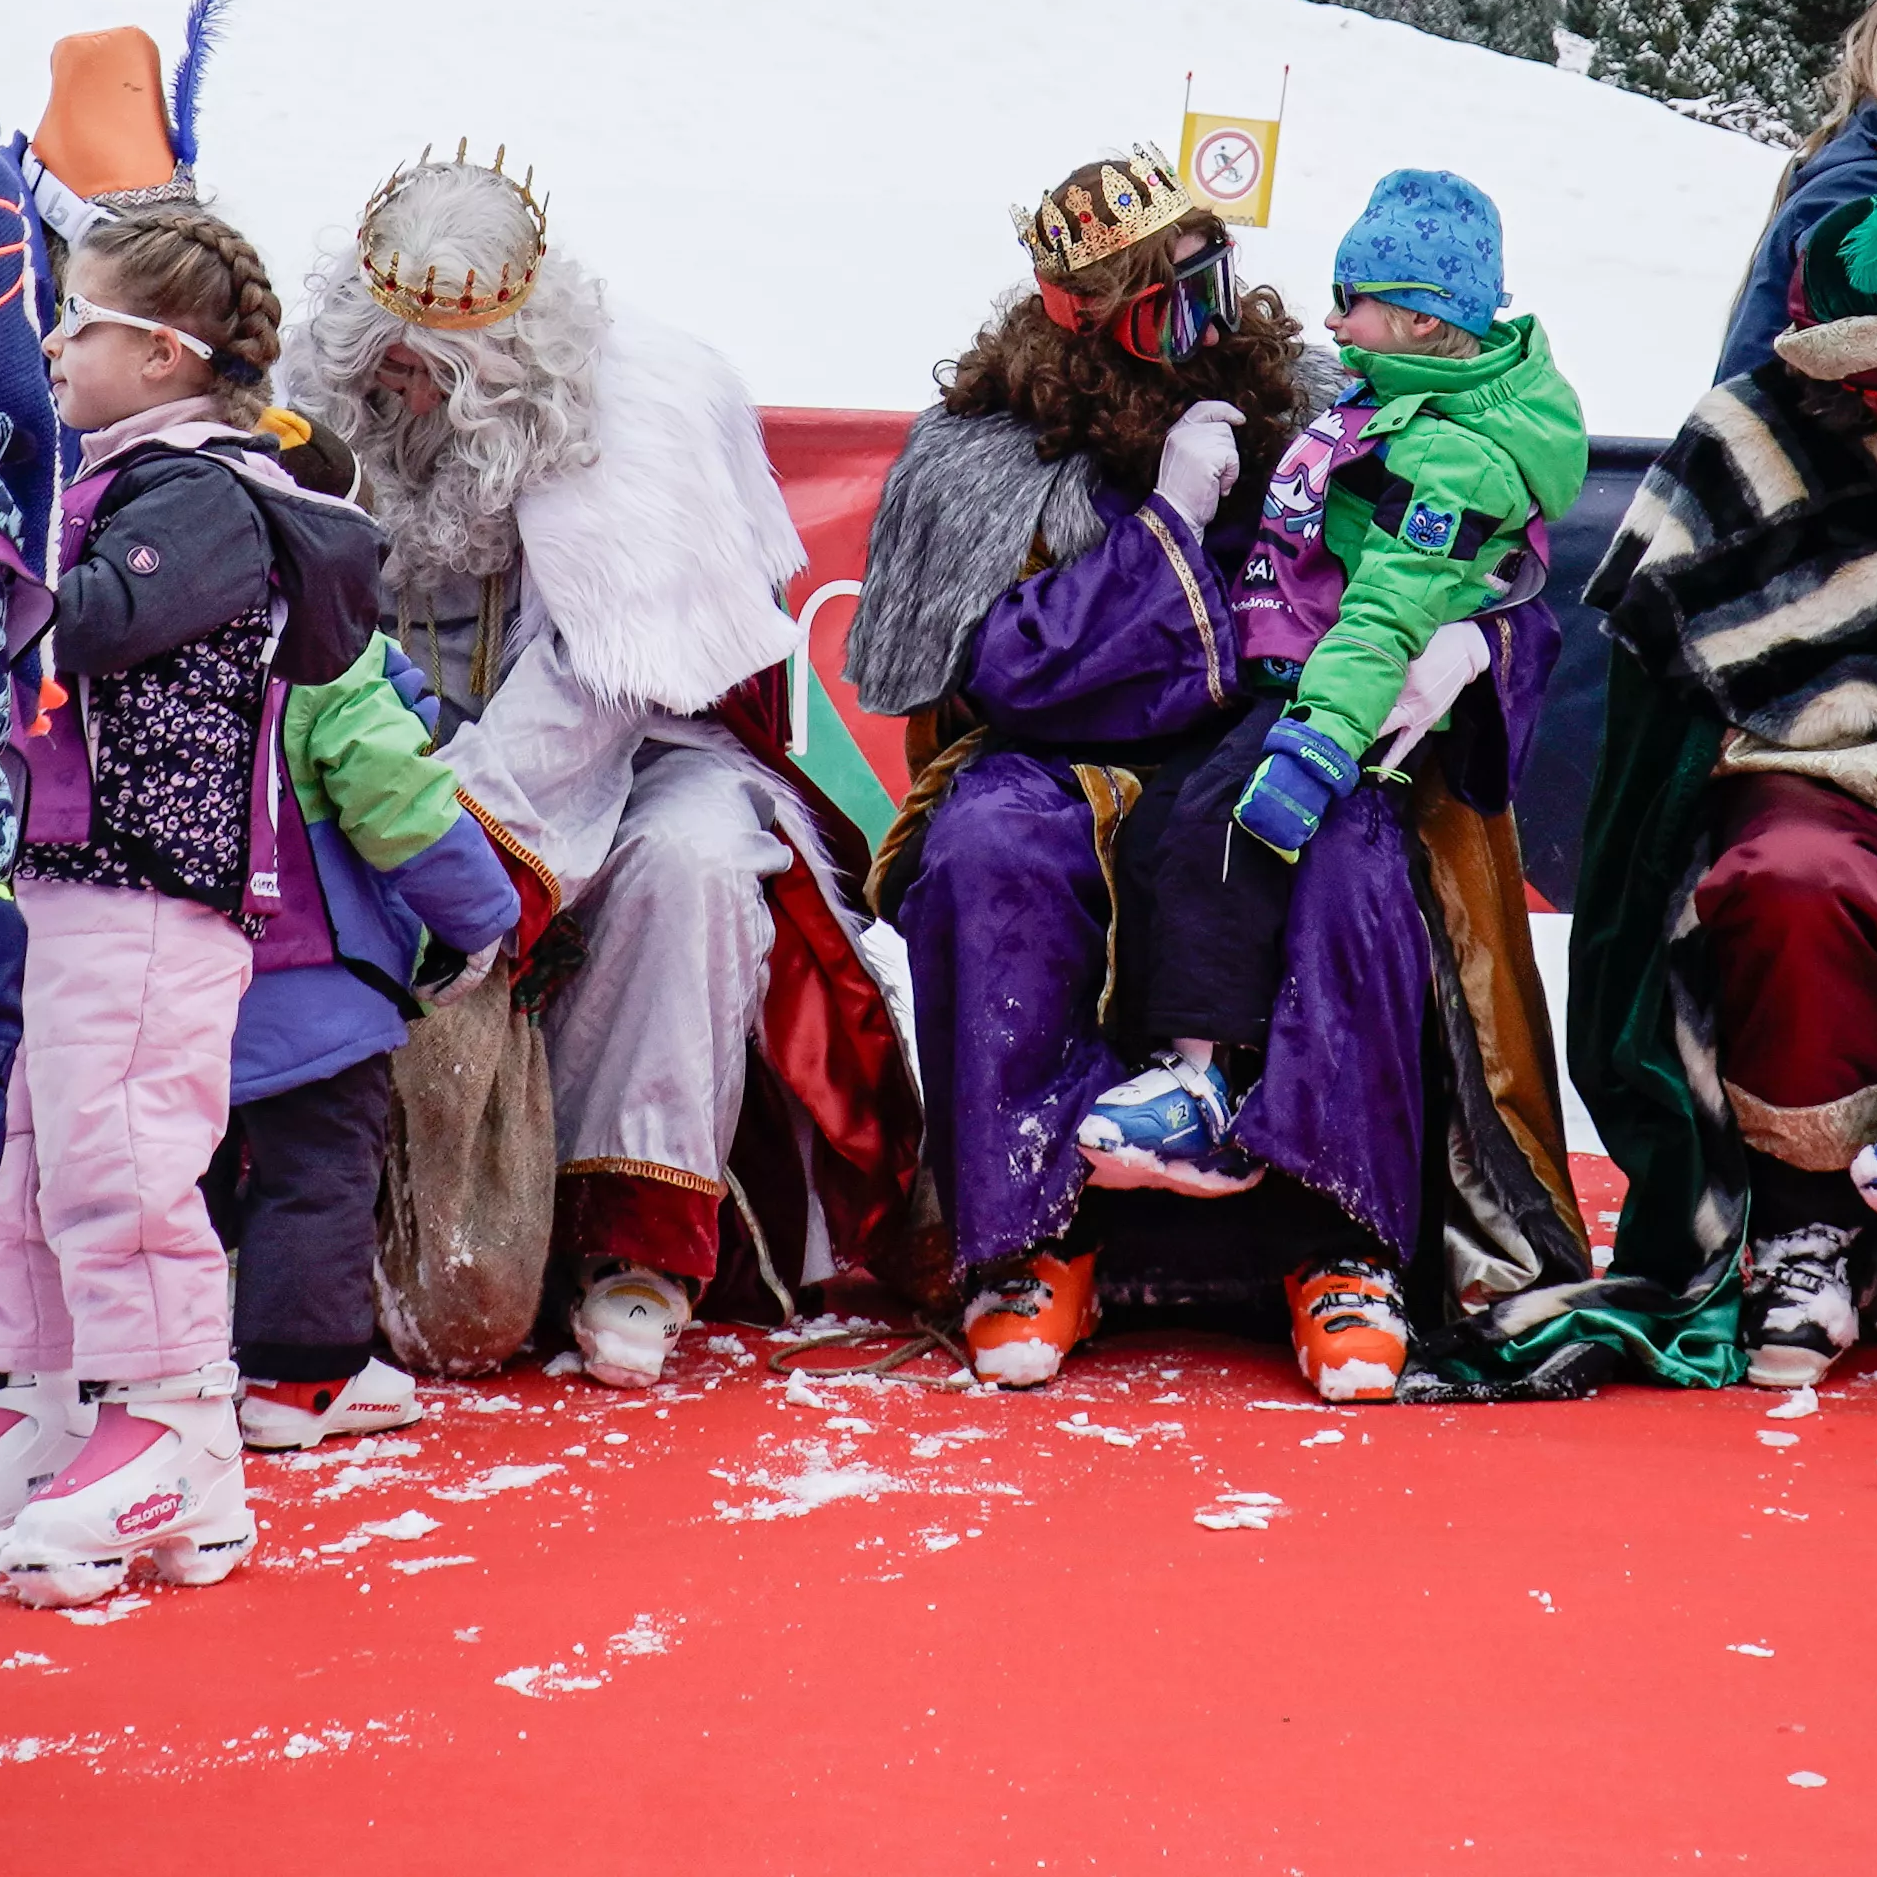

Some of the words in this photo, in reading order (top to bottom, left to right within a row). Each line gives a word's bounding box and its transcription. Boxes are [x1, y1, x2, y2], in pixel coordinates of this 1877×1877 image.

[1299, 745, 1344, 781] reusch
[346, 1403, 402, 1413] ATOMIC
[122, 1497, 179, 1531] salomon
